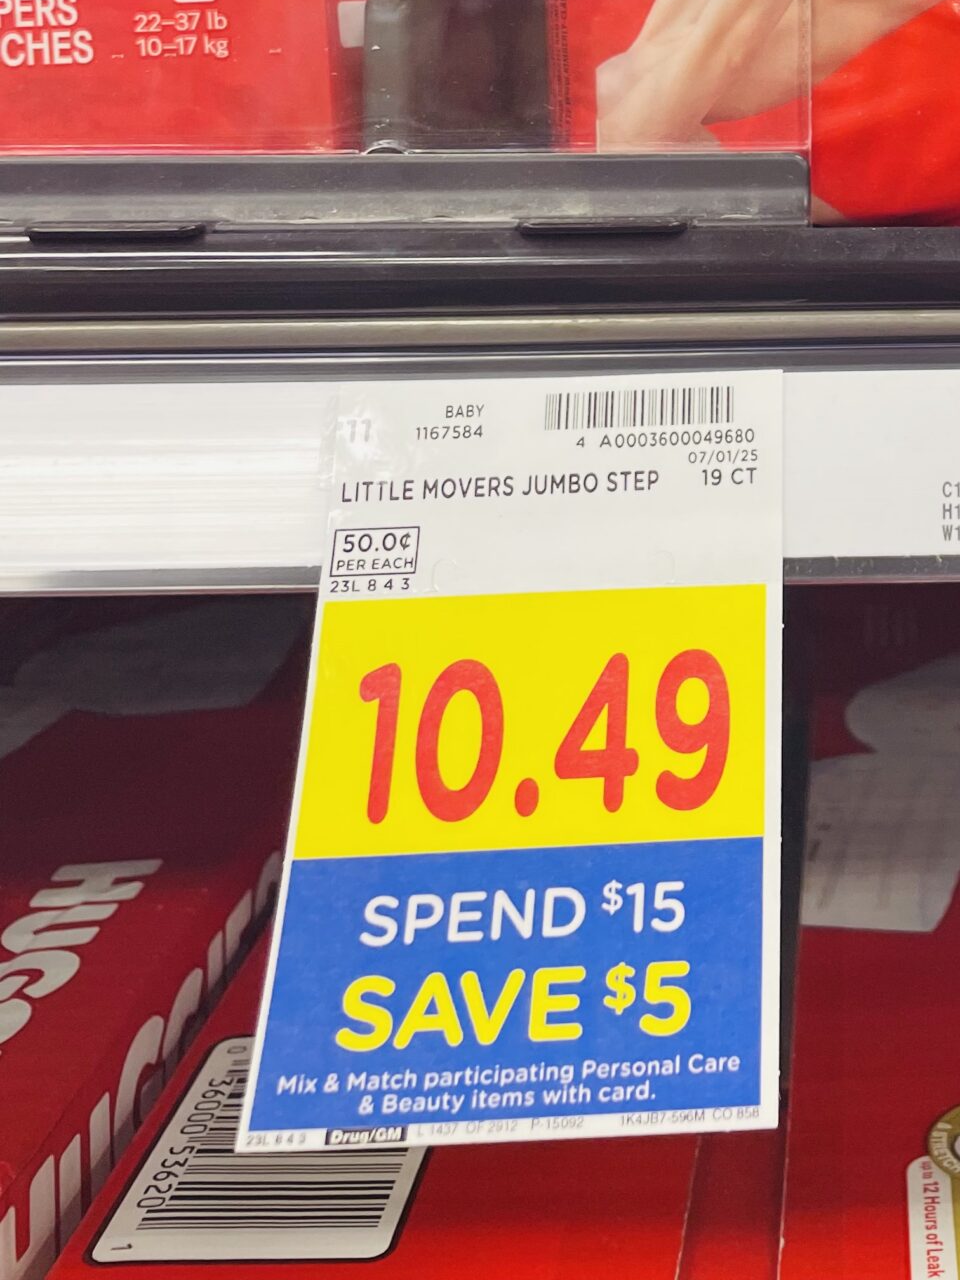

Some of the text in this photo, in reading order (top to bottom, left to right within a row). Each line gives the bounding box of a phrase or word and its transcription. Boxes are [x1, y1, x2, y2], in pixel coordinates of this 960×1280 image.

[206, 11, 228, 31] lb
[1, 30, 94, 67] CHES
[204, 35, 229, 59] kg
[445, 404, 485, 419] BABY
[416, 425, 484, 440] 1167584
[576, 428, 756, 449] 4 A0003600049680
[688, 449, 758, 465] 07/01/25
[341, 470, 660, 503] LITTLE MOVERS JUMBO STEP
[701, 467, 757, 486] 19 CT
[942, 481, 960, 498] C1
[942, 503, 960, 520] H1
[342, 532, 412, 554] 50.0¢
[942, 525, 960, 541] W1
[336, 556, 414, 572] PER EACH
[330, 577, 410, 594] 23L 8 4 3
[359, 648, 731, 825] 10.49
[359, 880, 686, 947] SPEND $15
[335, 960, 692, 1052] SAVE $5
[277, 1053, 741, 1095] Mix & Match participating Personal Care
[180, 1078, 234, 1135] 36000
[358, 1080, 656, 1116] & Beauty items with card.
[331, 1127, 402, 1144] Drug/GM
[136, 1145, 195, 1209] 53620
[923, 1182, 939, 1194] 12
[923, 1196, 941, 1231] Hours
[925, 1234, 943, 1245] of
[926, 1248, 945, 1278] Leak
